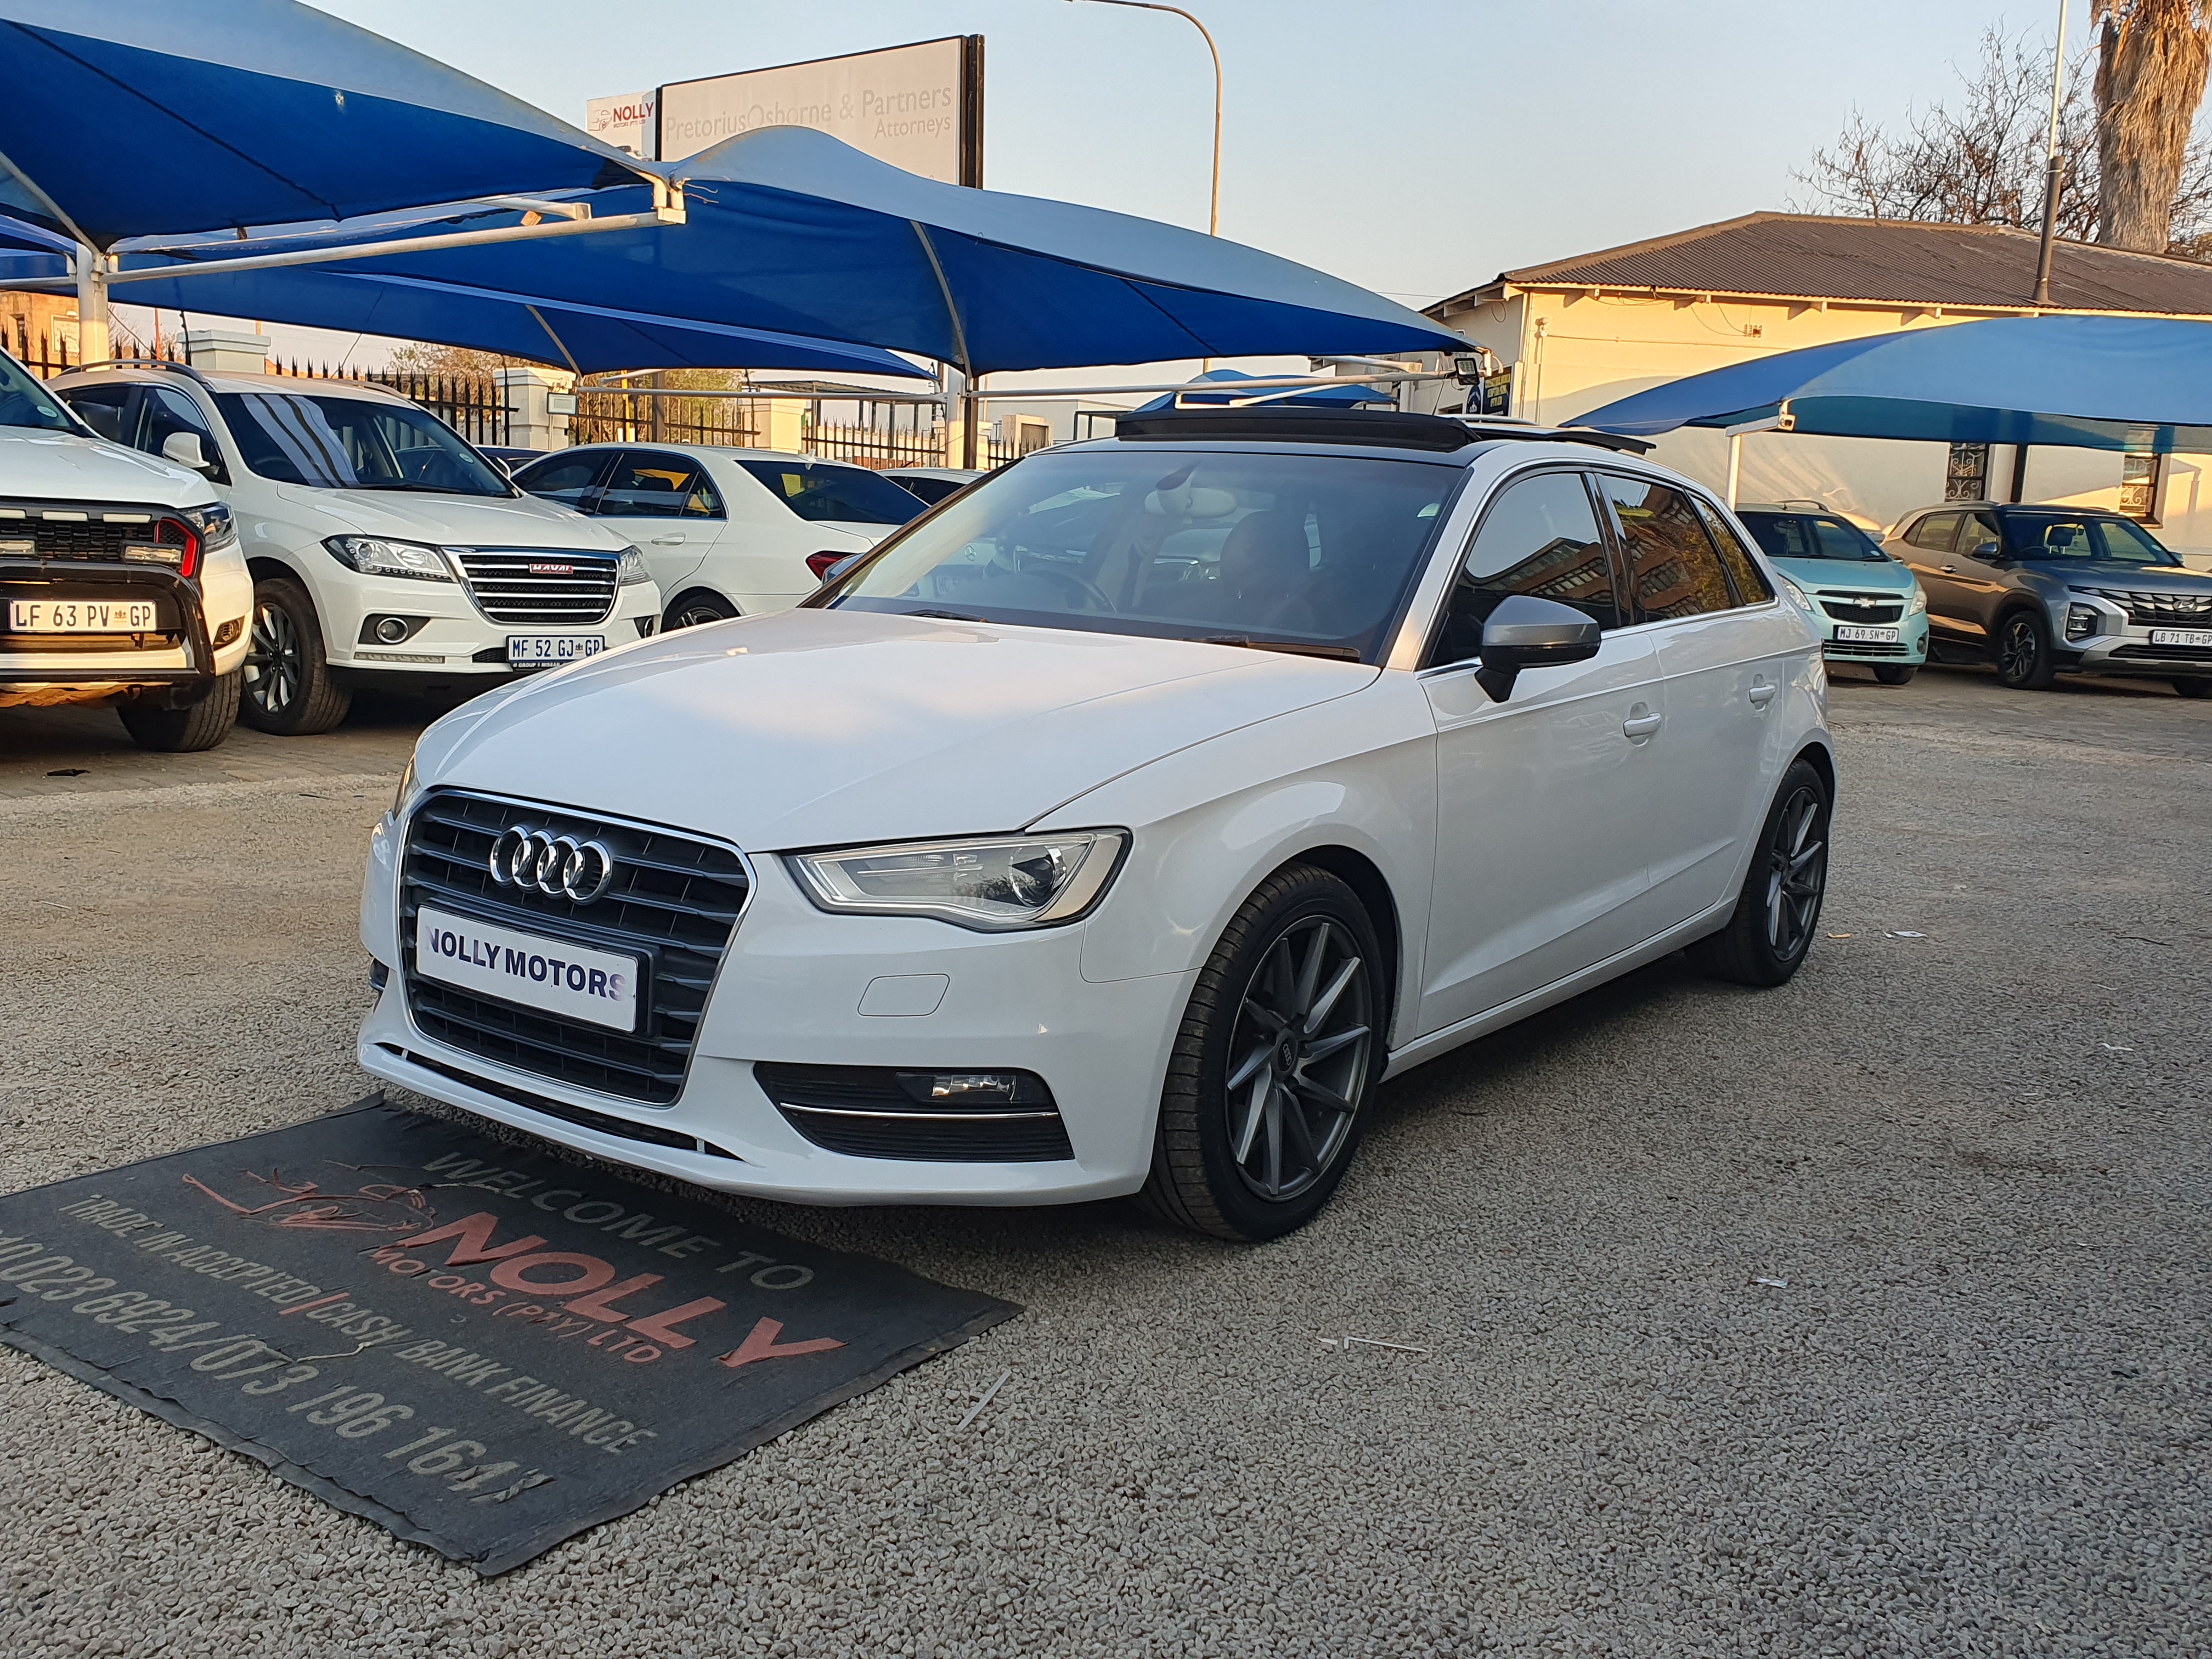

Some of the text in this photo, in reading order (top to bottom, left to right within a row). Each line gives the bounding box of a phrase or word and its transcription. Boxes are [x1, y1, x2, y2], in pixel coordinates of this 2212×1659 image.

[613, 101, 654, 122] NOLLY
[839, 93, 854, 120] &
[862, 87, 951, 117] Partners
[874, 116, 951, 139] Attorneys
[15, 605, 151, 627] LF 63 PV GP
[512, 640, 600, 657] MF 52 GJ GP
[1839, 628, 1896, 641] MJ 69 SN GP
[2155, 633, 2212, 644] LB 71 TB GP
[425, 926, 627, 1002] NOLLY MOTORS
[422, 1152, 815, 1290] WELCOME TO
[391, 1211, 848, 1368] NOLLY
[0, 1256, 117, 1301] 023
[285, 1384, 415, 1438] 196
[586, 1329, 662, 1363] LTD
[483, 1375, 658, 1454] FINANCE
